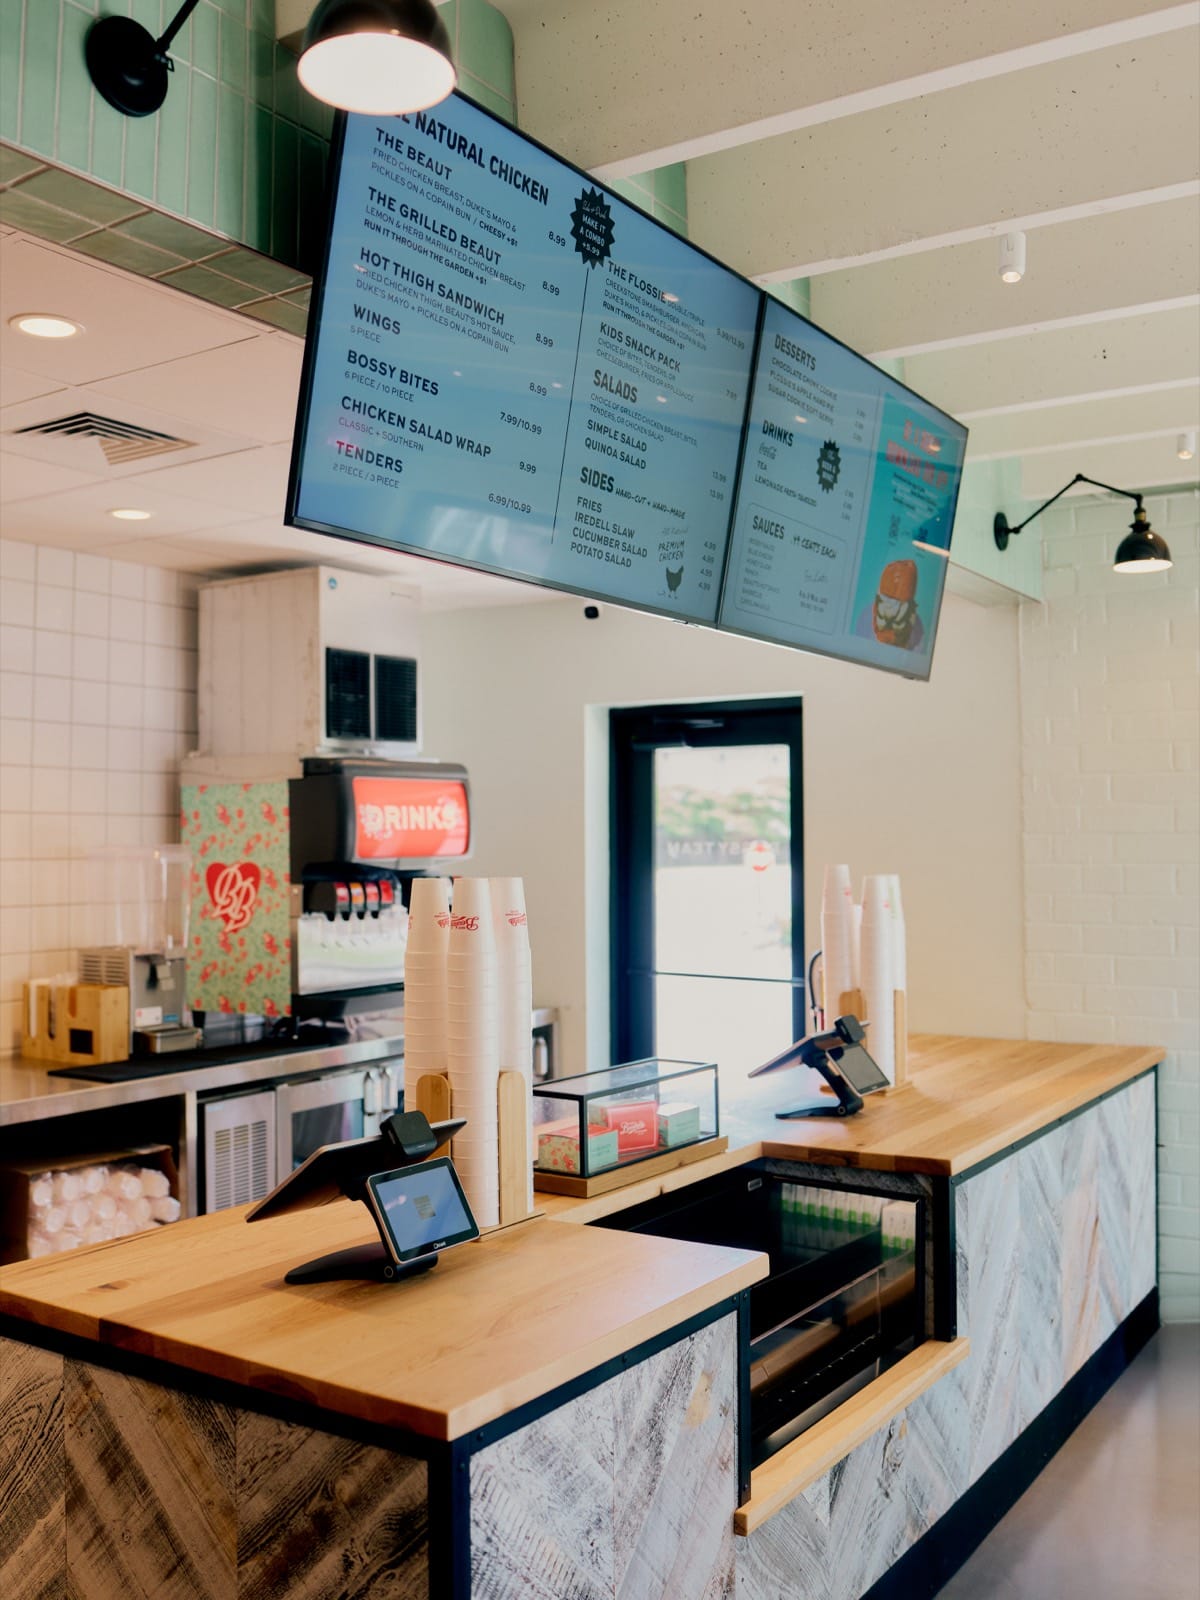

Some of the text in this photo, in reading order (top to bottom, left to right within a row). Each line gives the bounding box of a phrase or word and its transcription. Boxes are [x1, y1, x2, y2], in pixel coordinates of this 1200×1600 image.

[375, 126, 452, 182] THE BEAUT
[415, 108, 548, 207] NATURAL CHICKEN
[371, 160, 404, 186] PICKLES
[404, 178, 418, 193] ON
[419, 186, 425, 197] A
[425, 190, 454, 213] COPAIN
[455, 206, 470, 222] BUN
[479, 219, 505, 241] CHEESY
[373, 146, 397, 167] FRIED
[398, 160, 432, 187] CHICKEN
[492, 213, 510, 230] MAYO
[367, 186, 500, 266] THE GRILLED BEAUT
[548, 230, 565, 248] 8.99
[364, 218, 381, 234] RUN
[382, 228, 391, 239] IT
[391, 232, 428, 257] THROUGH
[428, 250, 443, 264] THE
[444, 257, 474, 279] GARDEN
[365, 204, 525, 292] LEMON & HERB MARINATED CHICKEN BREAST
[358, 265, 382, 283] RIED
[383, 276, 418, 299] CHICKEN
[476, 319, 490, 332] HOT
[360, 246, 504, 326] HOT THIGH SANDWICH
[542, 280, 559, 297] 8.99
[607, 260, 626, 281] THE
[628, 272, 666, 304] FLOSSIE
[352, 303, 401, 336] WINGS
[356, 326, 380, 344] PIECE
[387, 292, 409, 309] MAYO
[417, 305, 448, 326] PICKLES
[449, 320, 462, 332] ON
[467, 328, 493, 346] COPAIN
[494, 340, 508, 353] BUN
[535, 332, 553, 348] 8.99
[600, 322, 680, 372] KIDS SNACK PACK
[774, 333, 816, 372] DESSERTS
[344, 370, 350, 379] 6
[351, 372, 375, 388] PIECE
[381, 383, 390, 394] 10
[391, 387, 413, 402] PIECE
[346, 349, 439, 396] BOSSY BITES
[529, 381, 547, 397] 8.99
[592, 368, 638, 403] SALADS
[338, 416, 374, 435] CLASSIC
[381, 430, 423, 451] SOUTHERN
[341, 395, 491, 458] CHICKEN SALAD WRAP
[499, 411, 542, 435] 7.99/10.99
[586, 419, 647, 452] SIMPLE SALAD
[762, 419, 793, 447] DRINKS
[335, 440, 403, 473] TENDERS
[518, 460, 536, 474] 9.99
[584, 437, 646, 470] QUINOA SALAD
[339, 464, 364, 478] PIECE
[376, 474, 399, 489] PIECE
[579, 466, 614, 493] SIDES
[488, 492, 531, 514] 6.99/10.99
[576, 496, 602, 513] FRIES
[574, 511, 635, 539] IREDELL SLAW
[752, 515, 785, 540] SAUCES
[570, 542, 631, 567] POTATO SALAD
[572, 526, 648, 558] CUCUMBER SALAD
[365, 799, 457, 831] DRINKS
